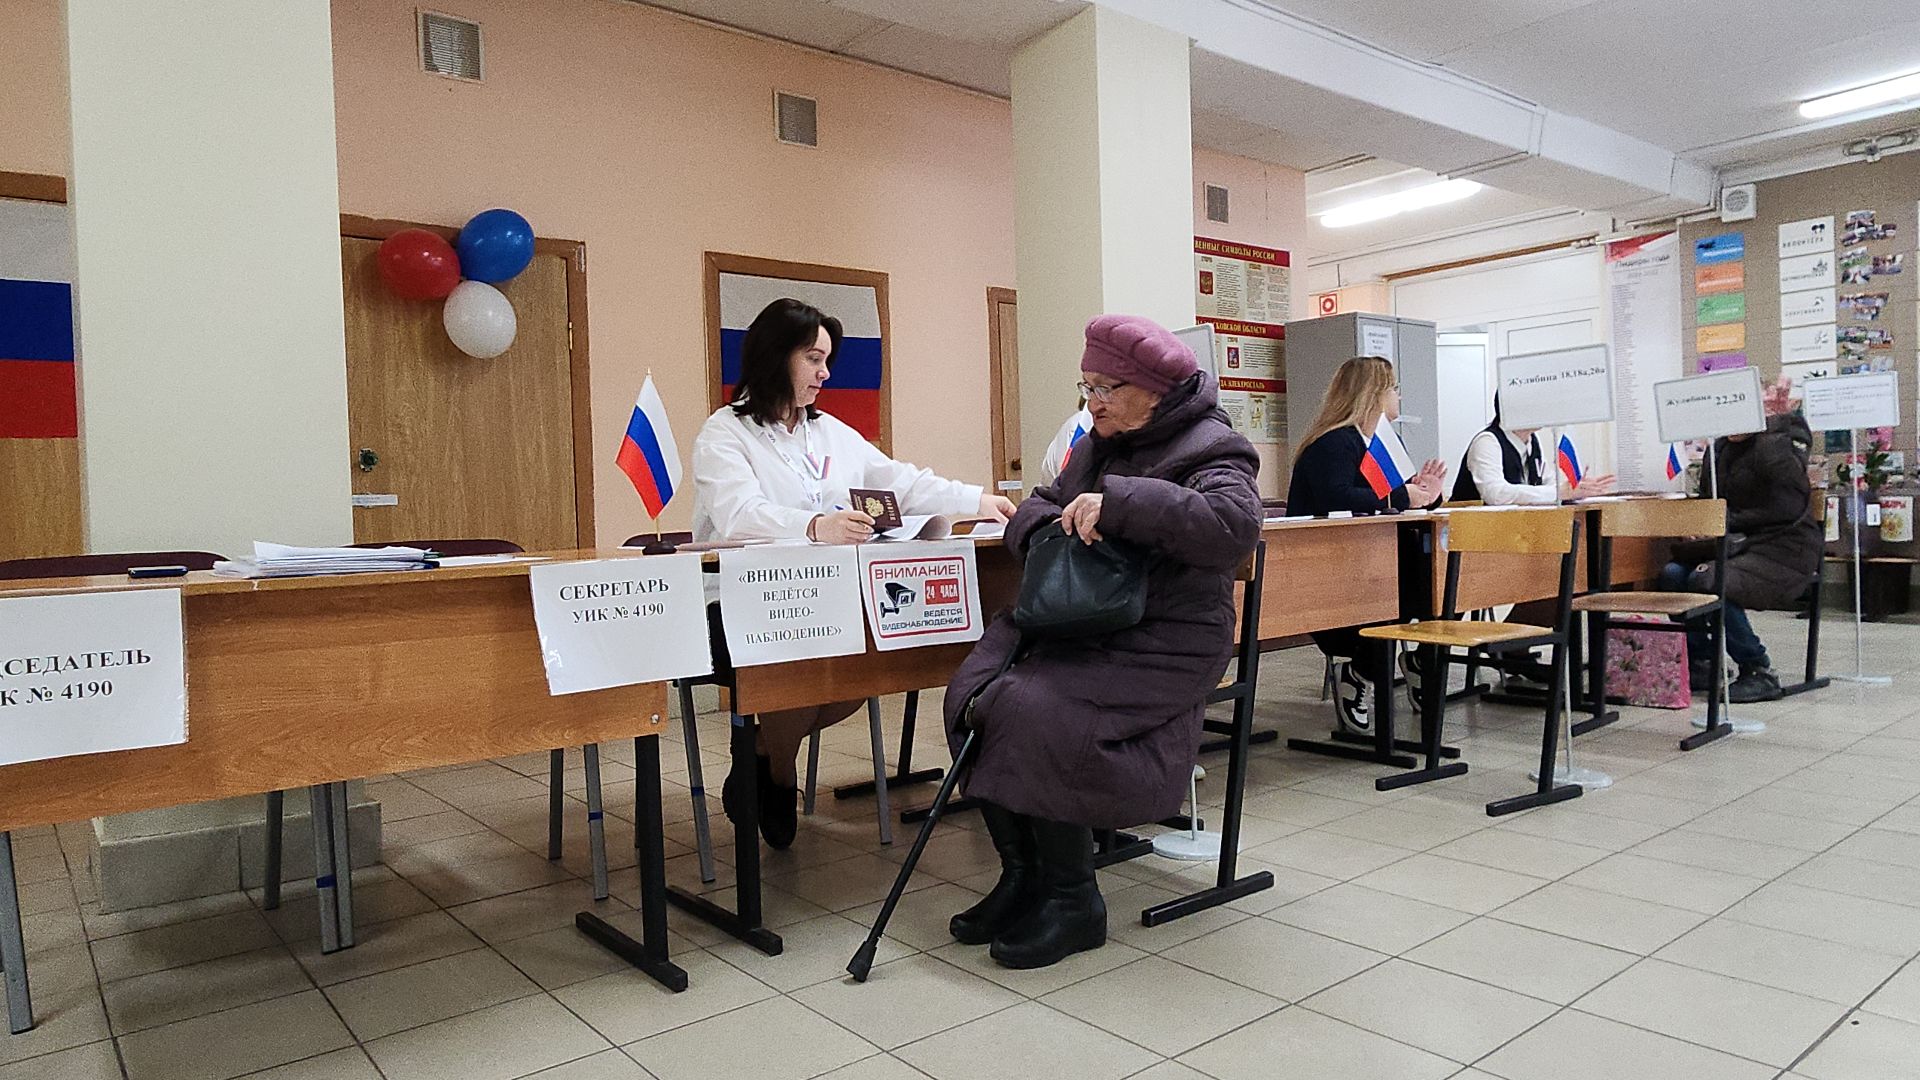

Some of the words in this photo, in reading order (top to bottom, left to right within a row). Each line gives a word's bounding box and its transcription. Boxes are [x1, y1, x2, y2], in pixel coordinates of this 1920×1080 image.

[1252, 249, 1275, 261] РОССИИ
[739, 565, 841, 584] «ВНИМАНИЕ!
[874, 564, 961, 580] ВНИМАНИЕ!
[559, 579, 670, 601] СЕКРЕТАРЬ
[763, 586, 819, 602] ВЕДЁТСЯ
[926, 585, 936, 599] 24
[940, 584, 959, 598] ЧАСА
[572, 608, 609, 624] УИК
[613, 606, 629, 620] №
[633, 603, 665, 617] 4190
[769, 606, 815, 620] ВИДЕО-
[924, 607, 963, 618] ВЕДЁТСЯ
[881, 616, 964, 631] ВИДЕОНАБЛЮДЕНИЕ
[745, 625, 842, 645] НАБЛЮДЕНИЕ»
[26, 686, 53, 704] №
[60, 680, 114, 700] 4190
